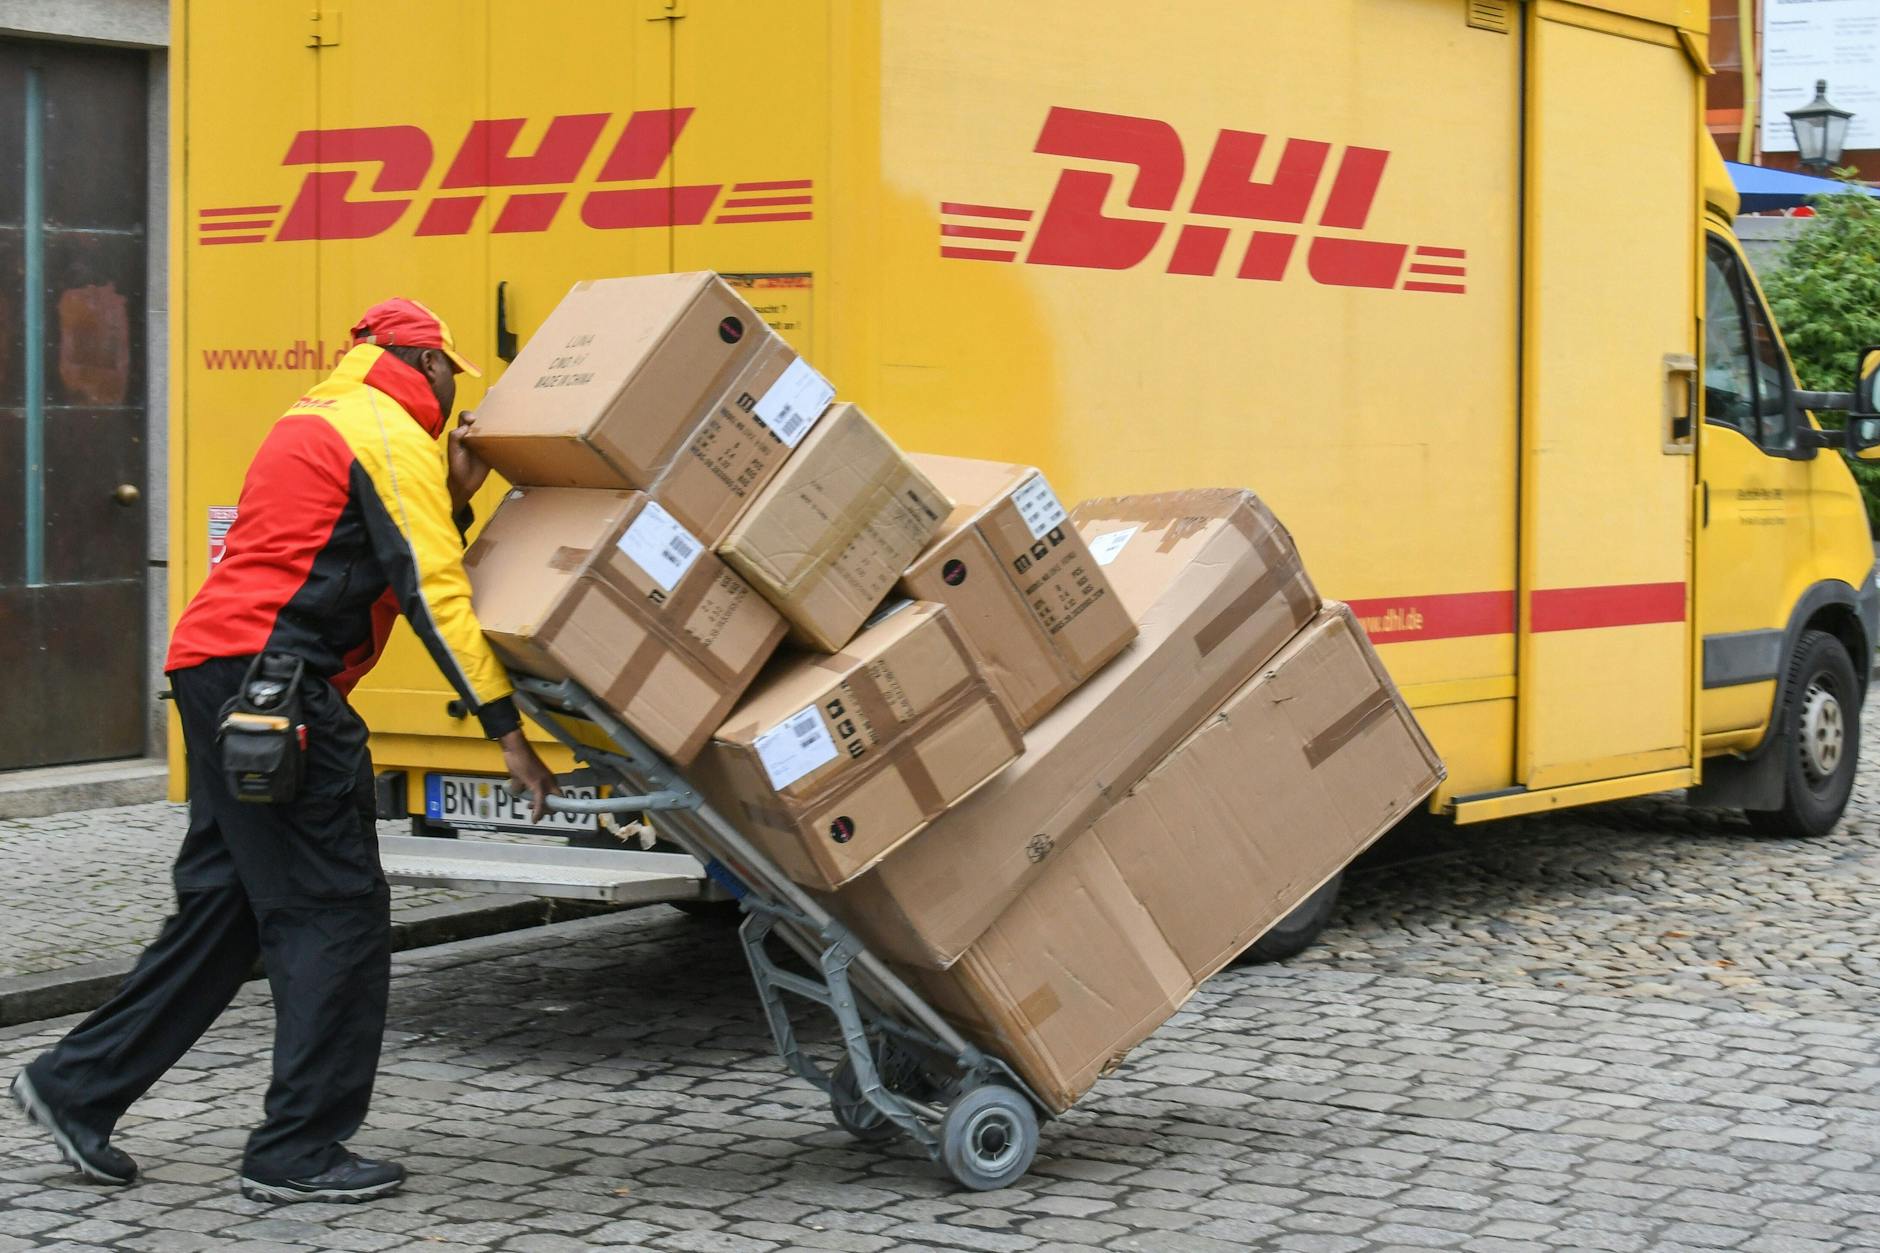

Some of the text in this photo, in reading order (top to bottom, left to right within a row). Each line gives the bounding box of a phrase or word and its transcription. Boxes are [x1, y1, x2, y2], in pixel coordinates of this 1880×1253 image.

[274, 107, 723, 242] DHL
[1024, 106, 1409, 290] DHL
[203, 340, 350, 371] www.dhl.d
[444, 781, 476, 816] BN
